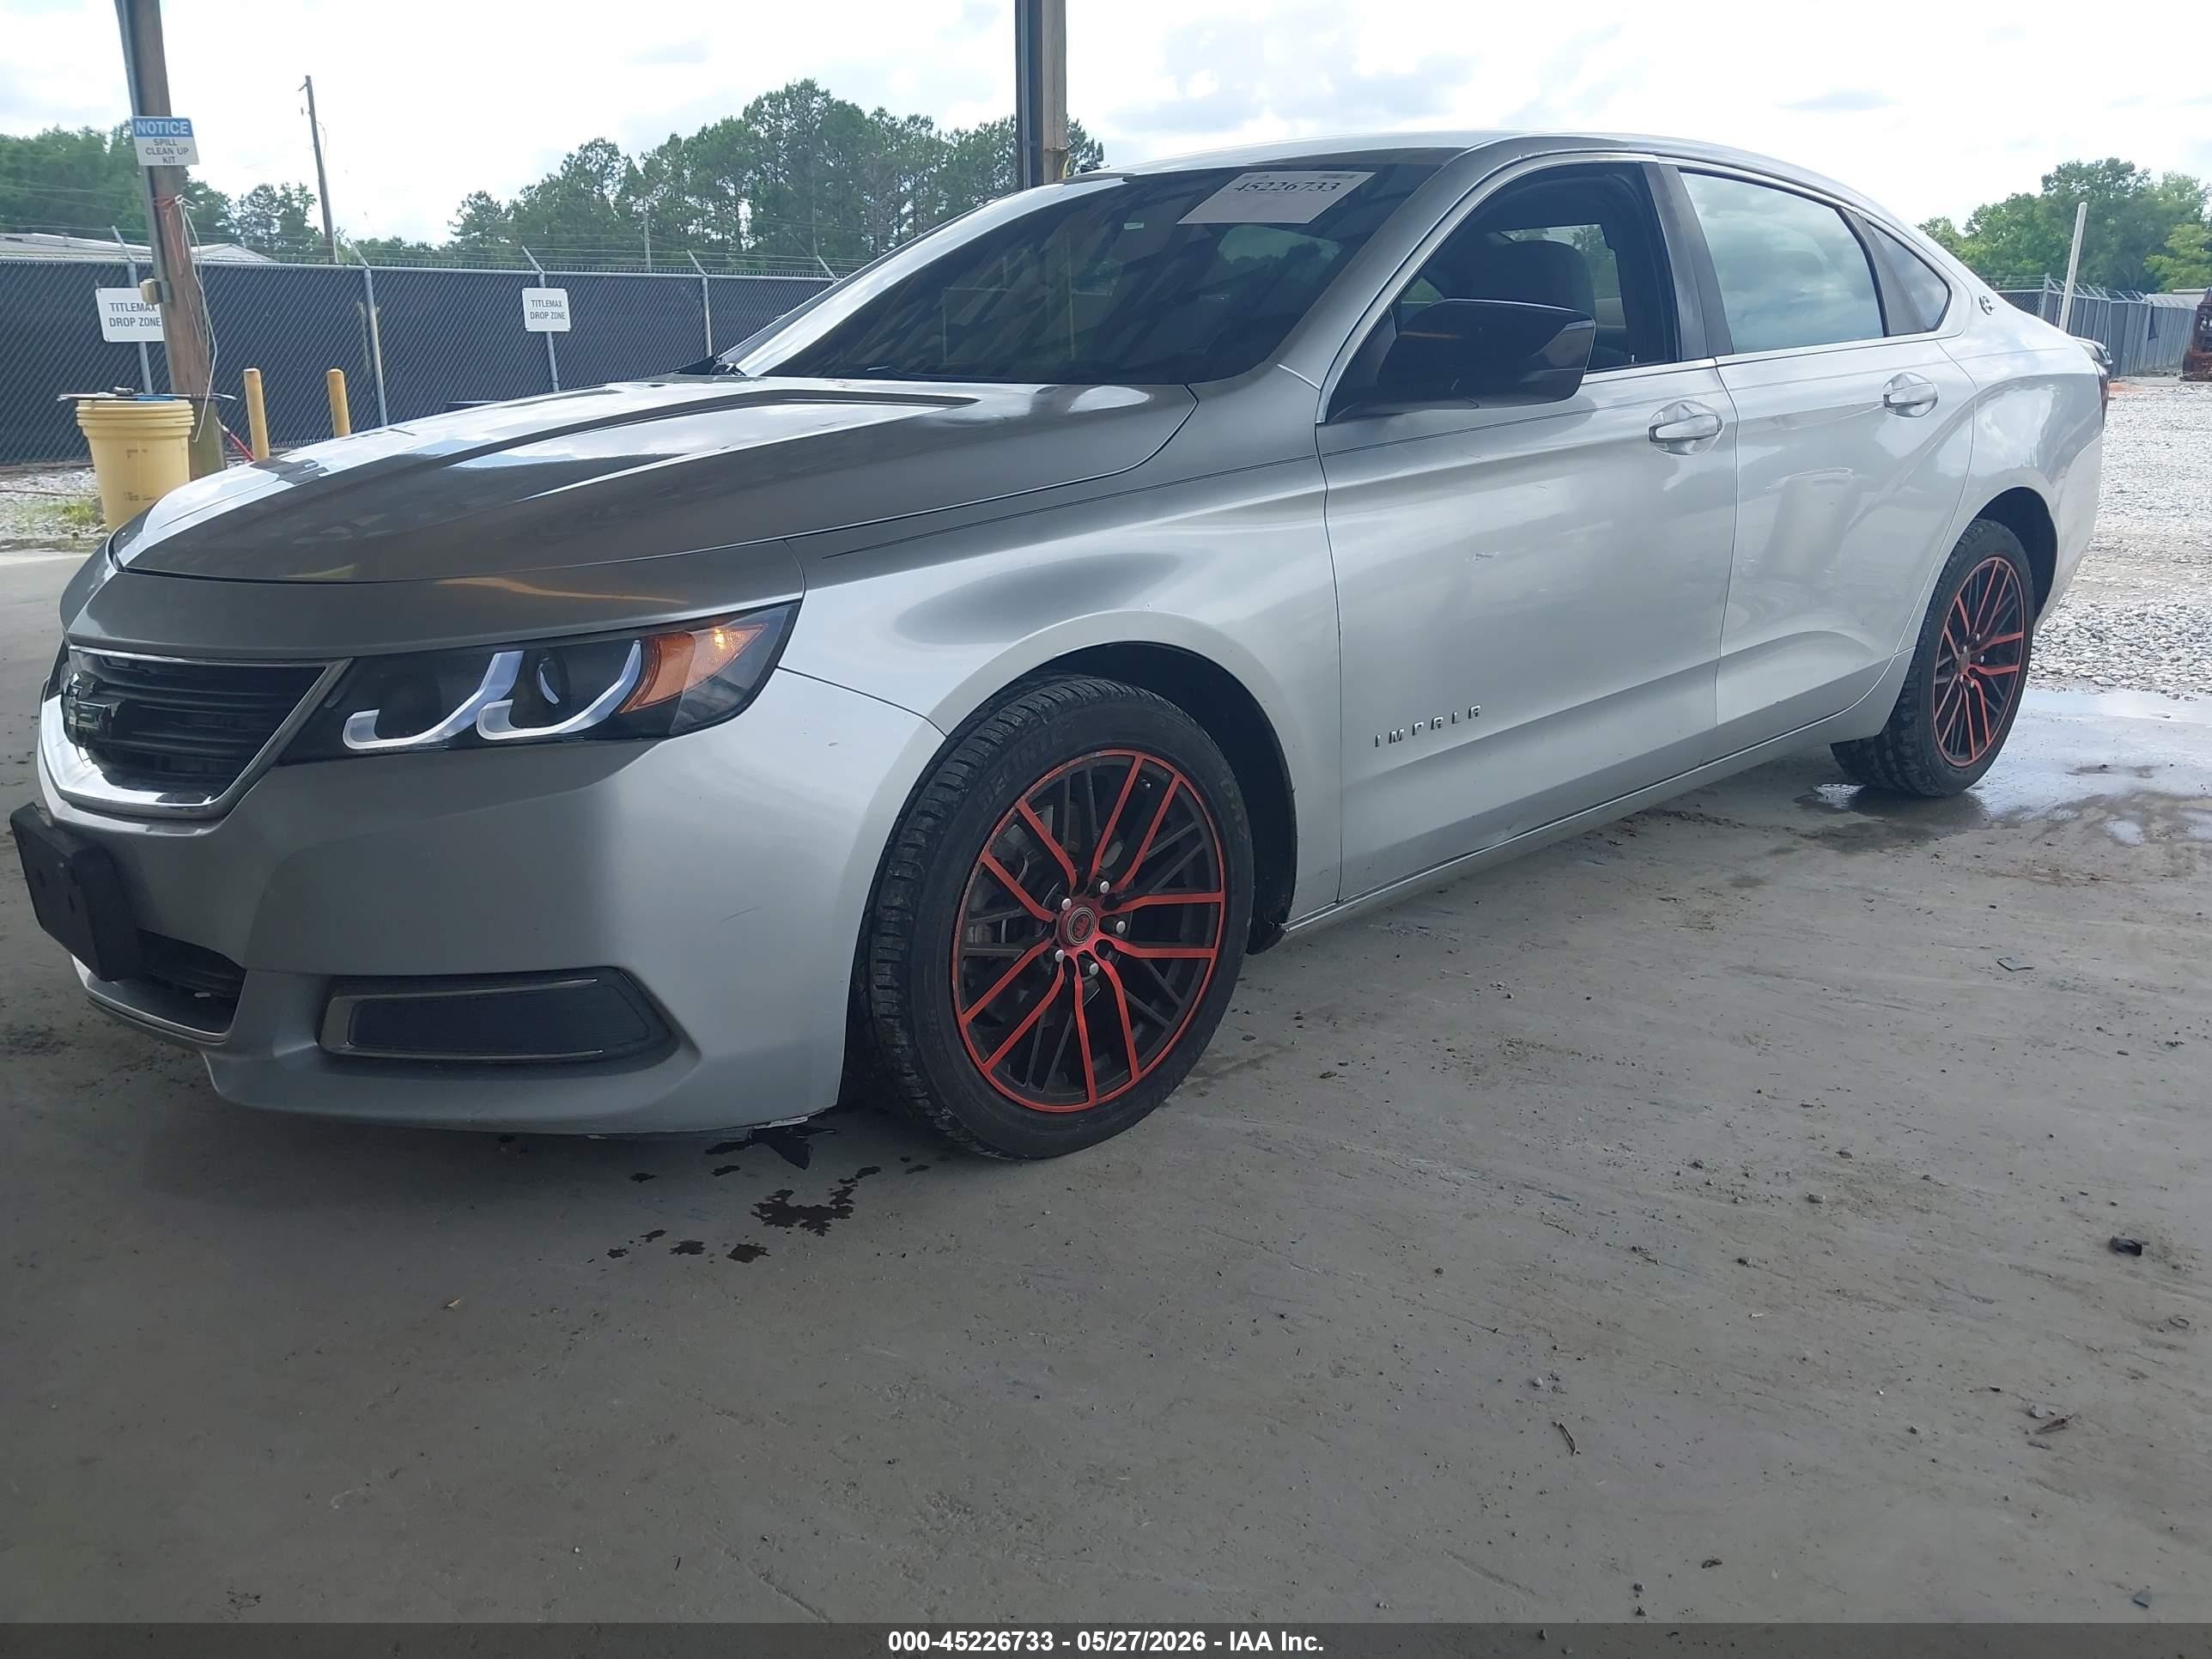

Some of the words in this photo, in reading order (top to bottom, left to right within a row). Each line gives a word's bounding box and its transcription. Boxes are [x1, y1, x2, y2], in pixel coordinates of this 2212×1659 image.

[136, 120, 190, 135] NOTICE
[153, 137, 178, 146] SPILL
[145, 147, 174, 155] CLEAN
[177, 147, 189, 155] UP
[162, 155, 176, 164] KIT
[1234, 181, 1341, 191] 45226733
[109, 302, 157, 313] TITLEMAX
[531, 299, 562, 308] TITLEMAX
[529, 311, 550, 320] DROP
[550, 311, 566, 320] ZONE
[108, 317, 136, 327] DROP
[138, 317, 161, 327] ZONE
[1375, 705, 1481, 748] IMPALA
